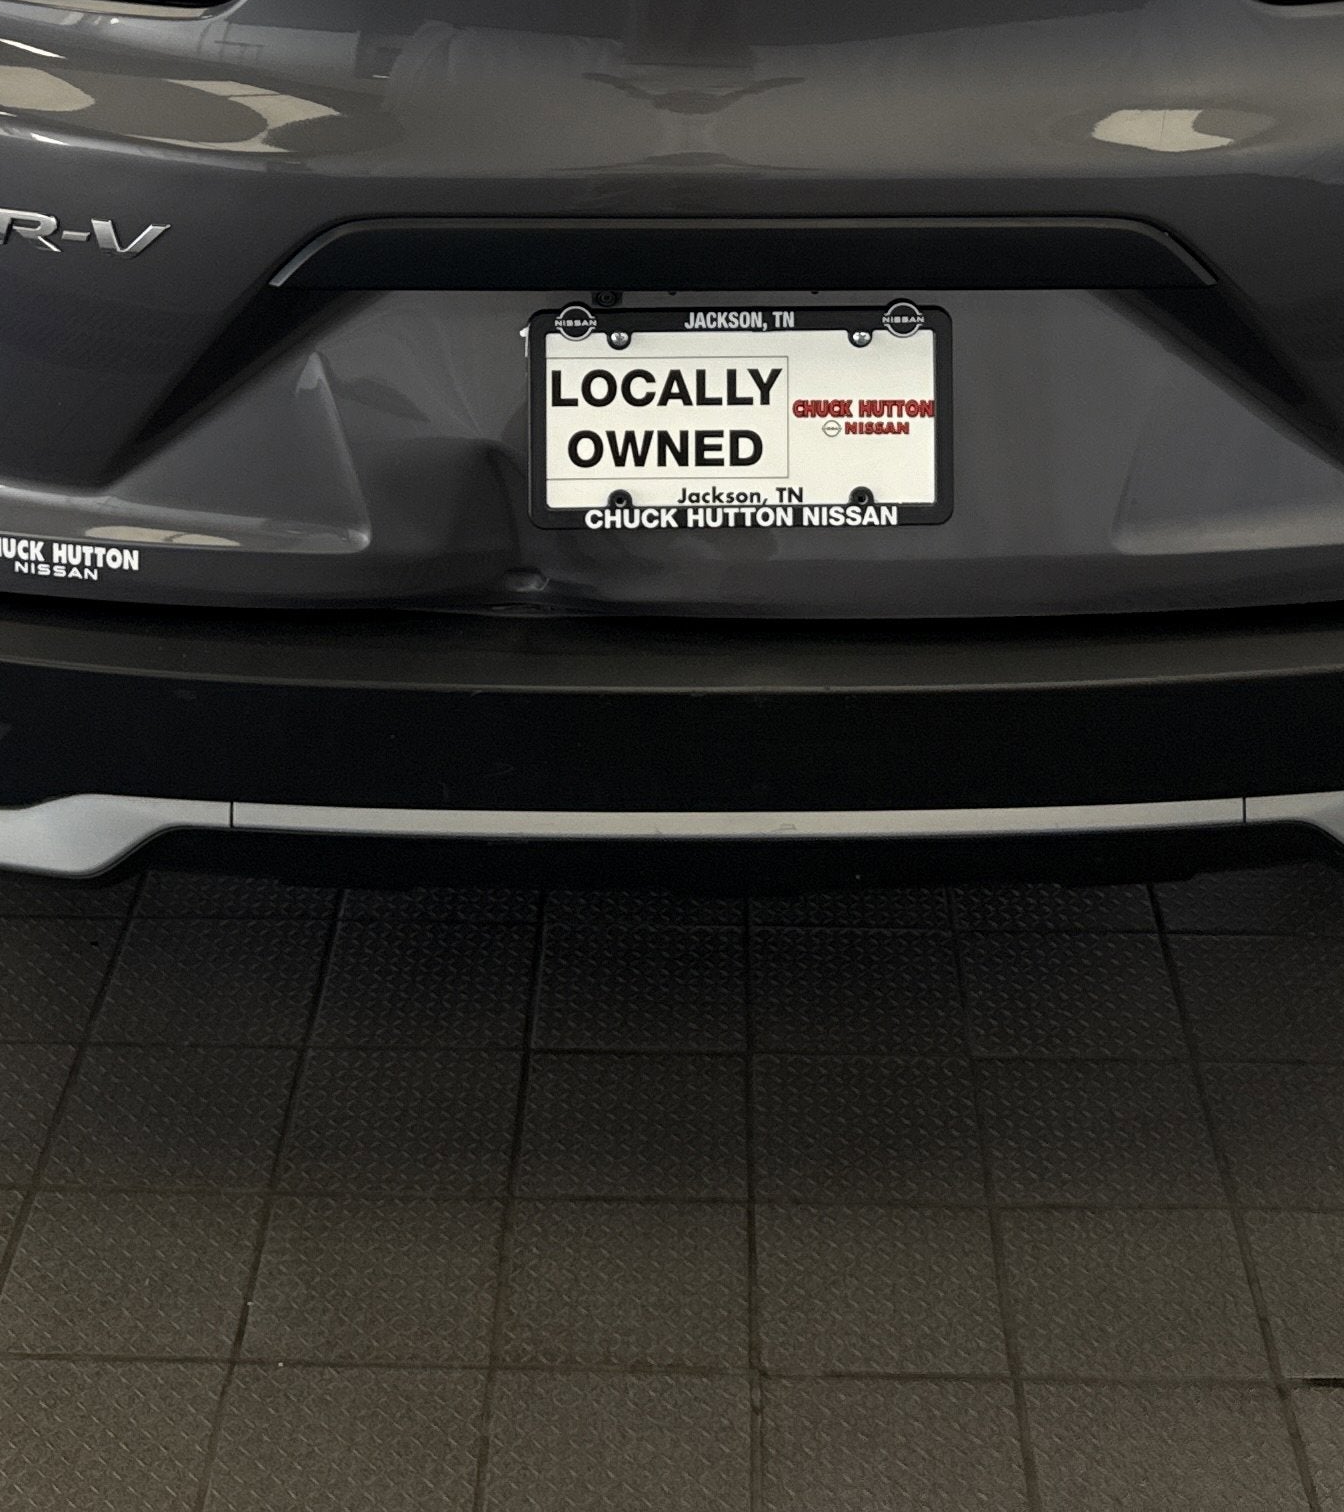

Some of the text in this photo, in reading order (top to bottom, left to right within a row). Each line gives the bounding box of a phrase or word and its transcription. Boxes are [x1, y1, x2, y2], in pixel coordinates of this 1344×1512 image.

[555, 319, 598, 327] NISSAN
[684, 311, 795, 330] JACKSON, TN
[882, 315, 925, 323] NISSAN
[551, 368, 783, 407] LOCALLY
[792, 399, 935, 418] CHUCK HUTTON
[844, 421, 910, 435] NISSAN
[567, 429, 764, 468] OWNED
[677, 487, 804, 505] Jackson, TN
[584, 506, 898, 529] CHUCK HUTTON NISSAN
[53, 542, 140, 570] HUTTON
[14, 562, 98, 581] NISSAN
